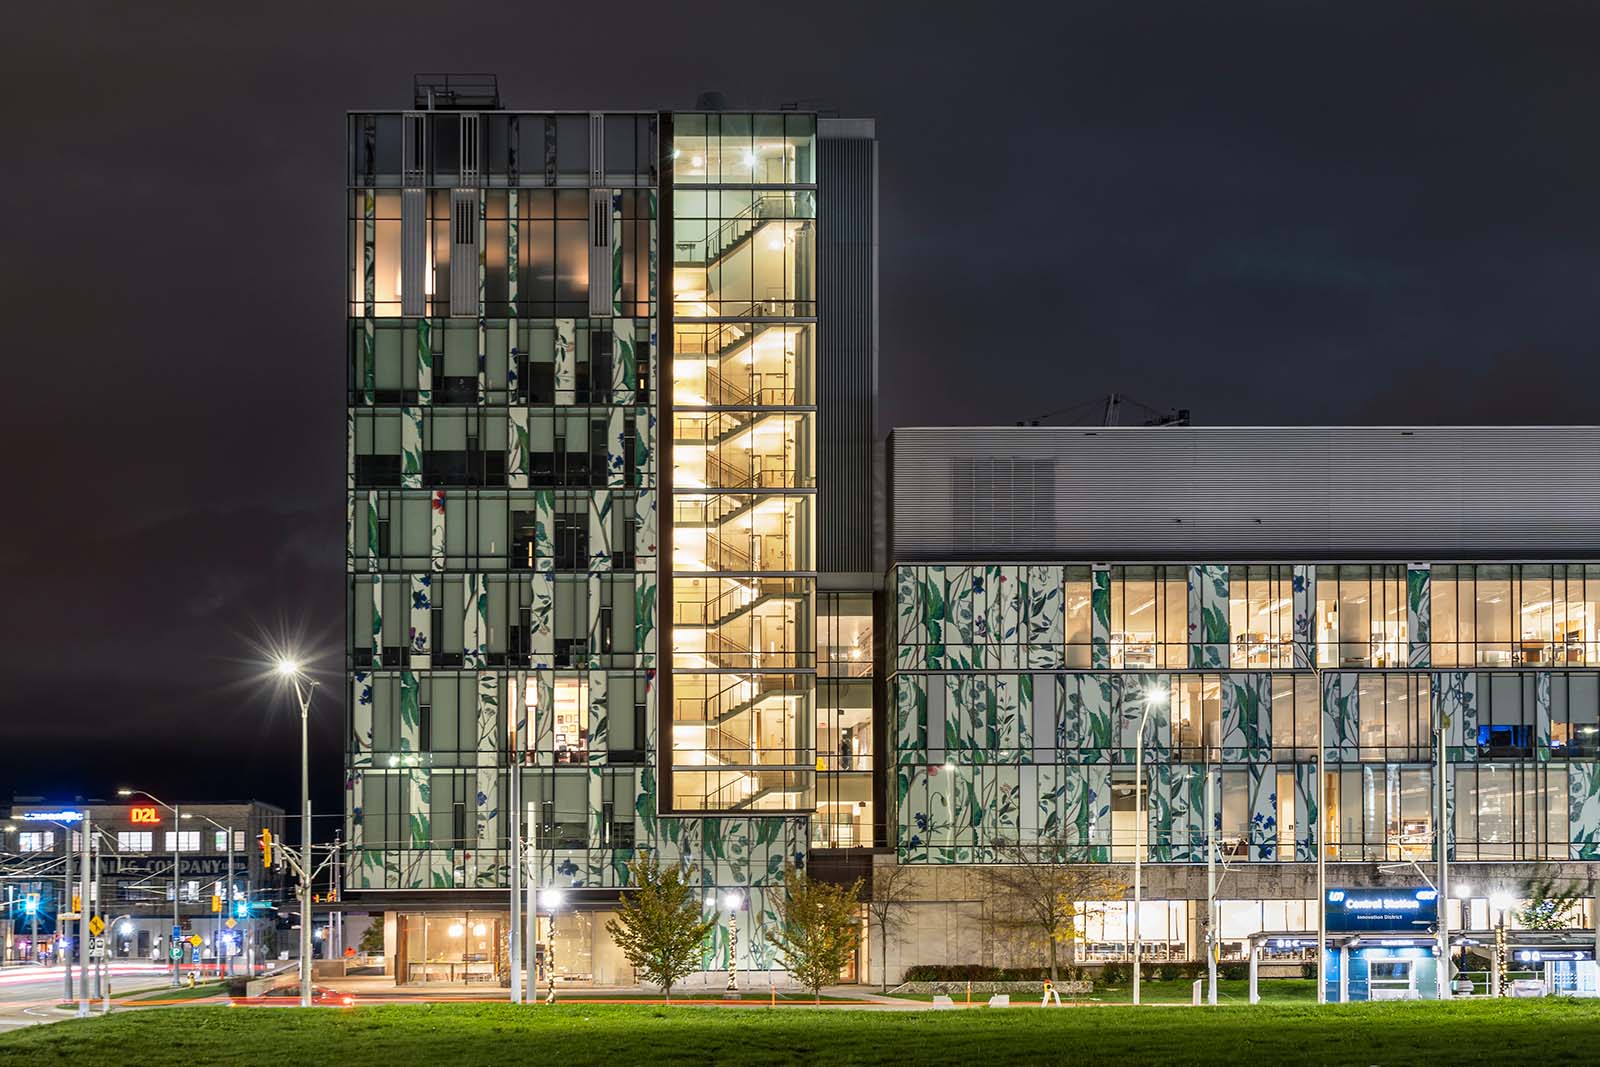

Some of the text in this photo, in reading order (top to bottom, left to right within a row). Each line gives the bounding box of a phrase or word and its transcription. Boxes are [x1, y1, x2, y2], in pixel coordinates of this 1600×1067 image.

[131, 808, 160, 822] D2L
[1345, 898, 1420, 909] Central Station
